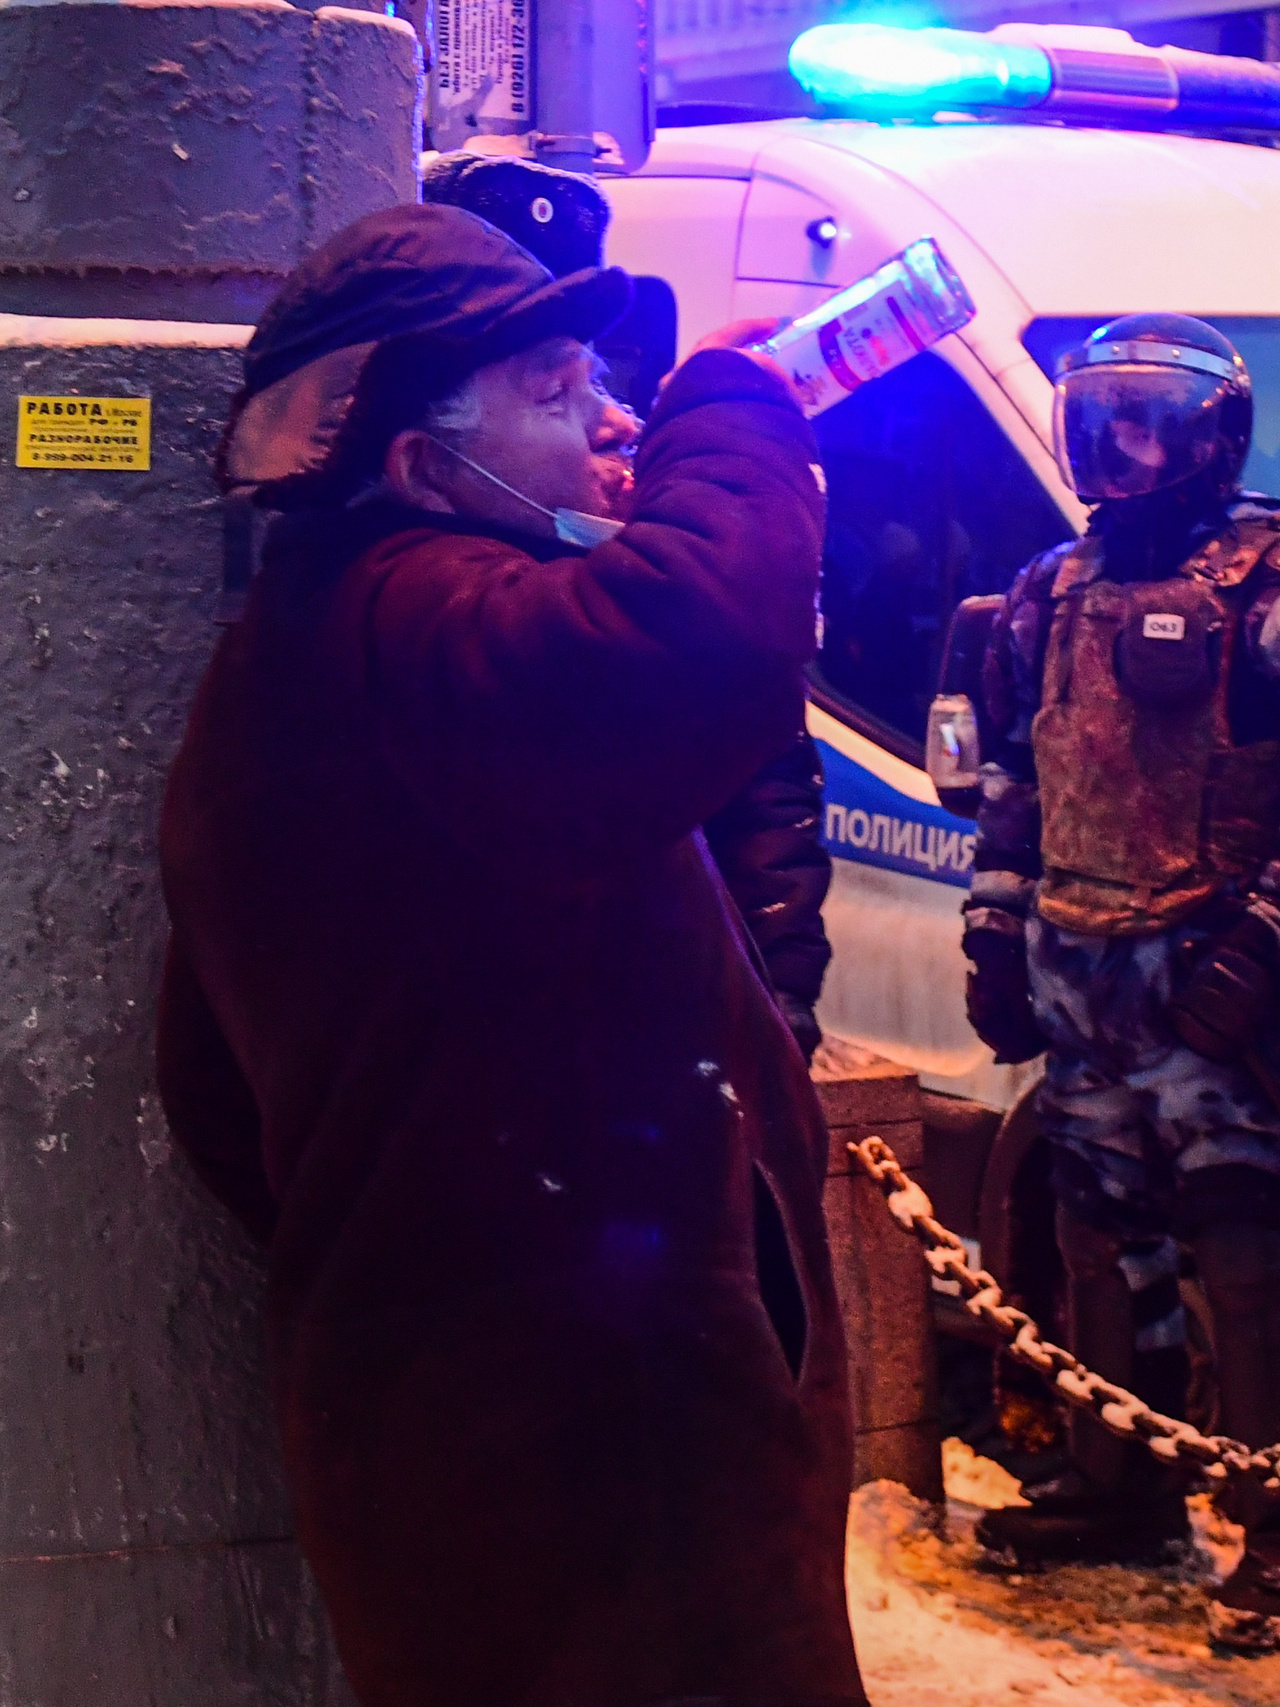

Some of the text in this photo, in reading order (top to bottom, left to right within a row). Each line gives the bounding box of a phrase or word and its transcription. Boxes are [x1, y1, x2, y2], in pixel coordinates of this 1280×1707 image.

[27, 402, 102, 416] РАБОТА
[29, 434, 138, 445] РАЗНОРАБОЧИЕ
[825, 803, 978, 872] ПОЛИЦИЯ
